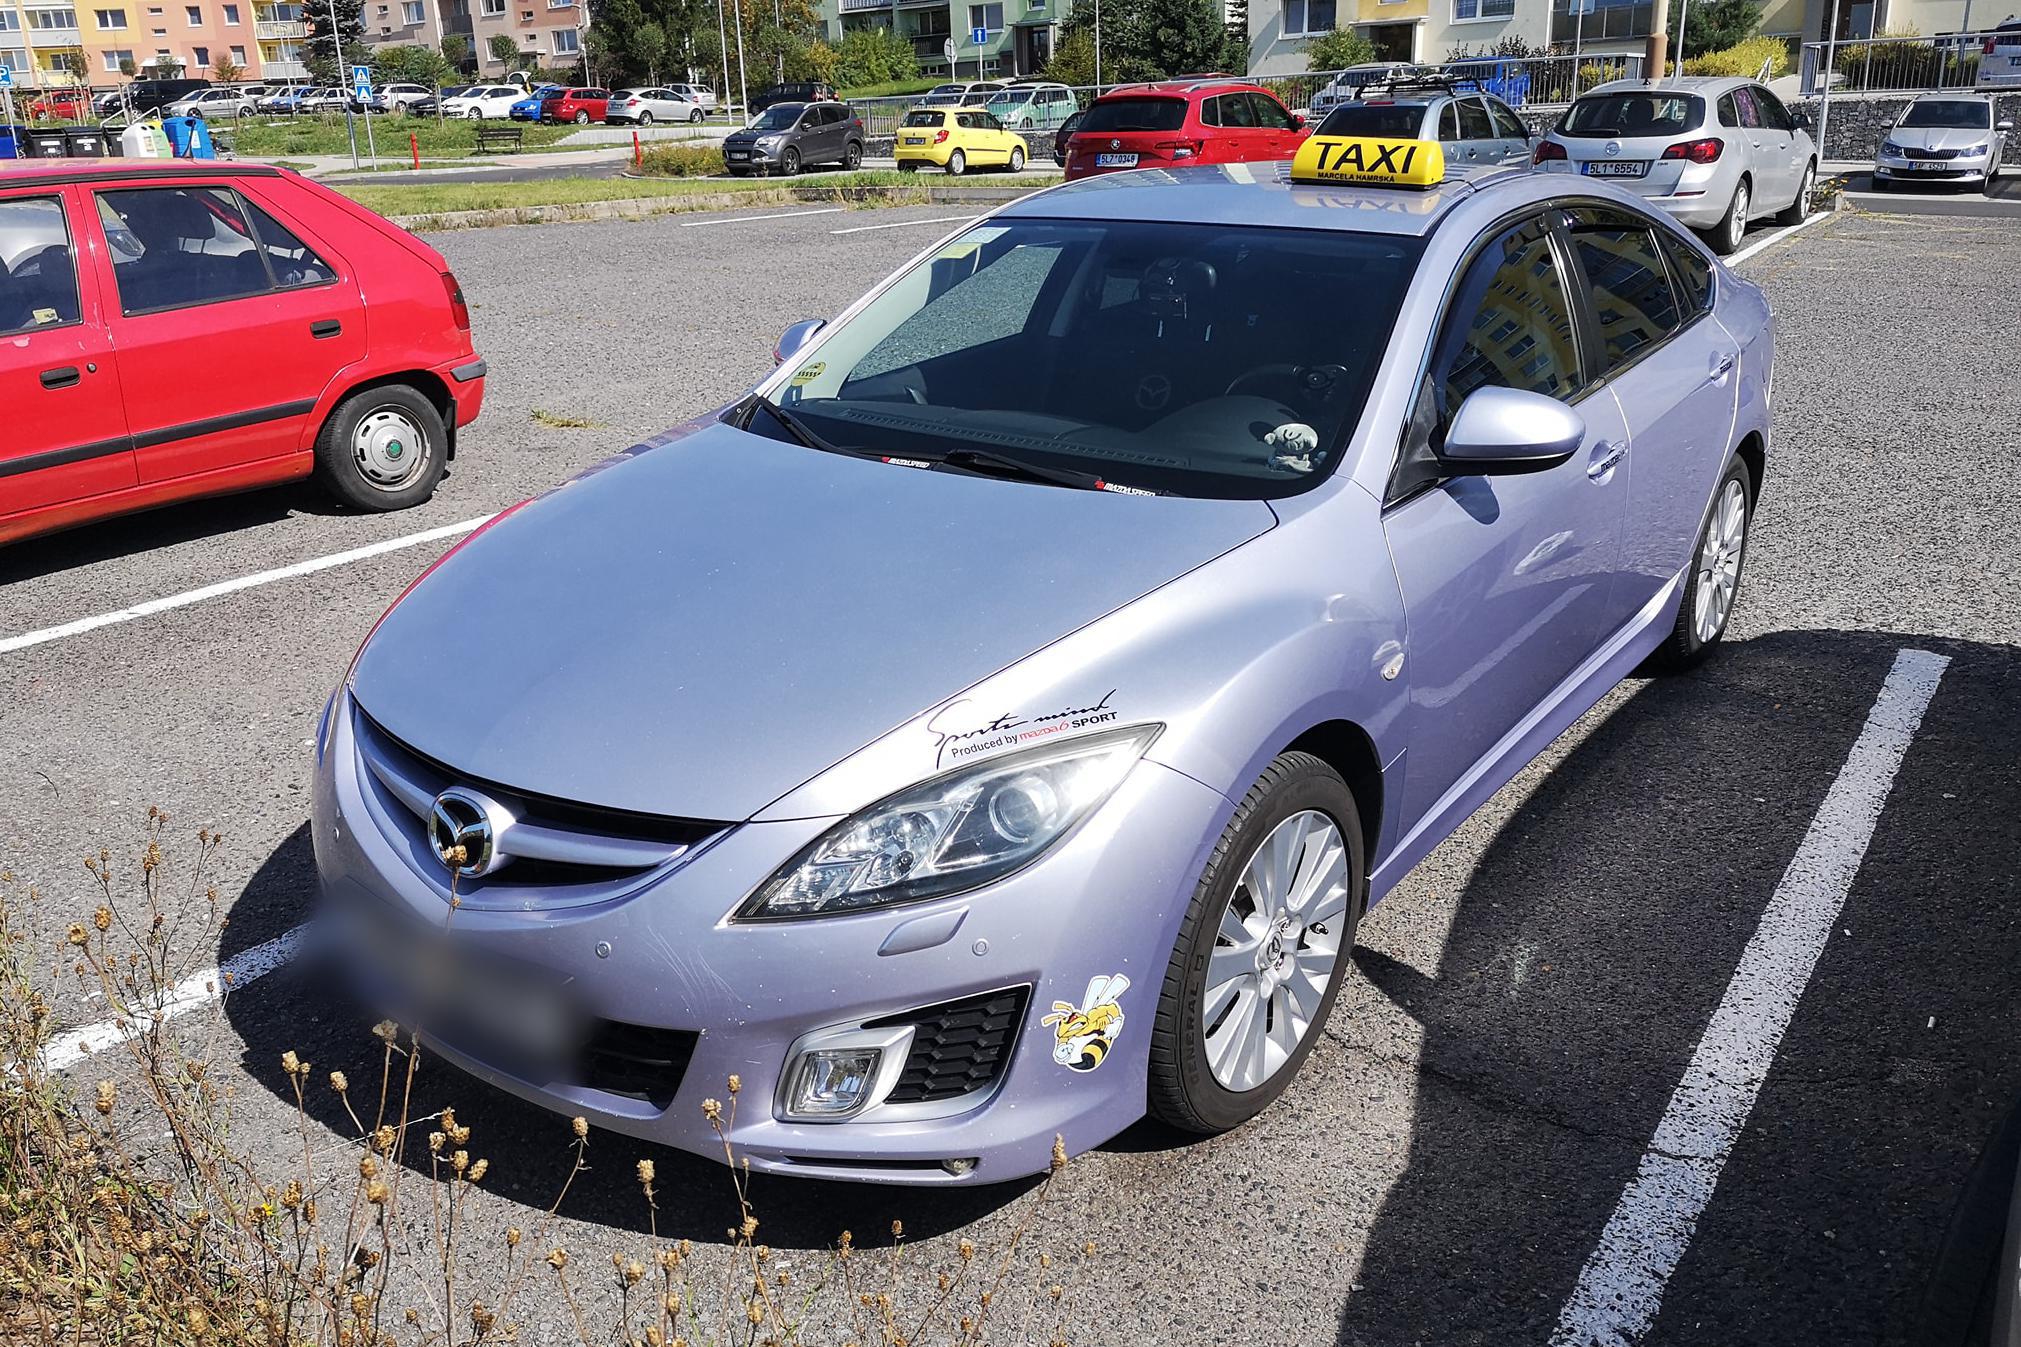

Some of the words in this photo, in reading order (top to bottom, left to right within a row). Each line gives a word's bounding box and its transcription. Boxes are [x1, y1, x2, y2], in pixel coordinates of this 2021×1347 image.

[1316, 142, 1418, 174] TAXI
[1590, 163, 1607, 174] 5L1
[1614, 163, 1638, 174] 6554
[1317, 171, 1355, 181] MARCELA
[951, 735, 1003, 758] Produced
[1005, 733, 1019, 746] by
[1071, 711, 1118, 729] SPORT
[1185, 982, 1200, 1085] GENERAL
